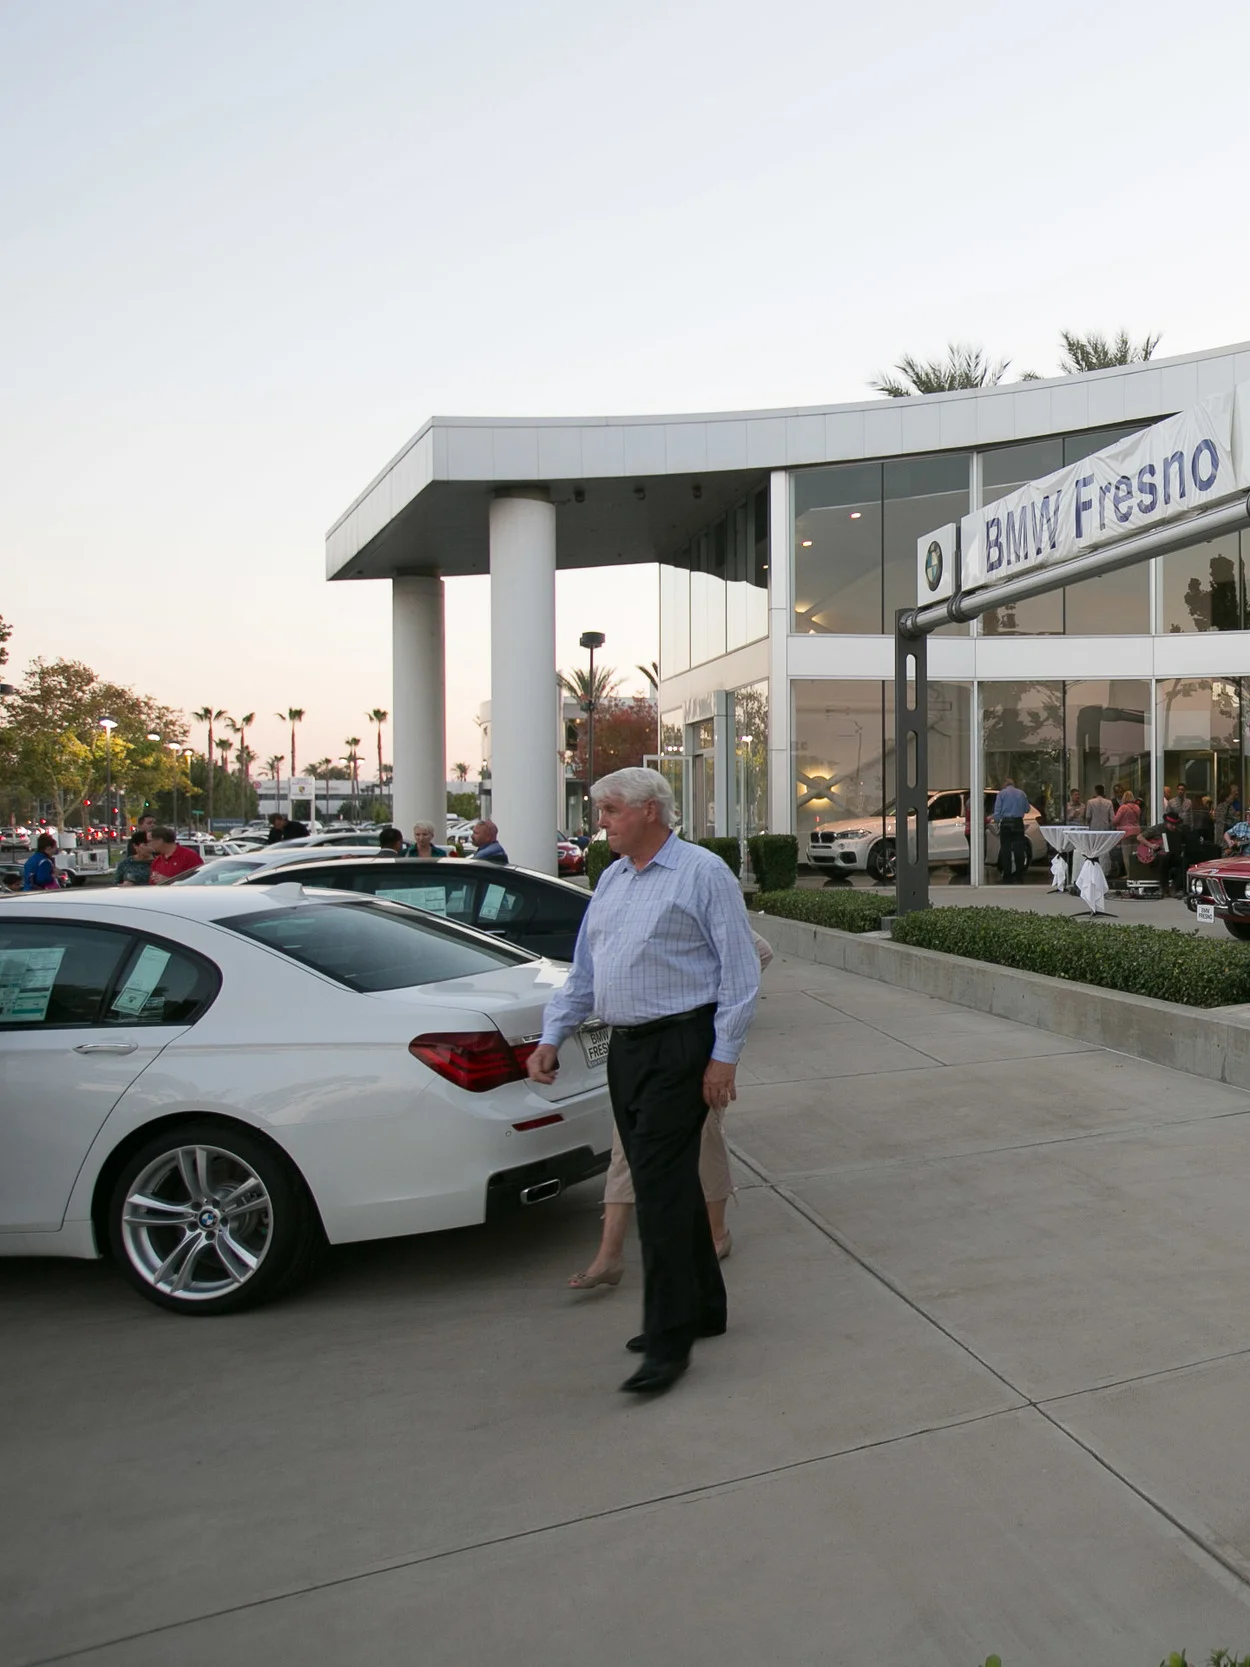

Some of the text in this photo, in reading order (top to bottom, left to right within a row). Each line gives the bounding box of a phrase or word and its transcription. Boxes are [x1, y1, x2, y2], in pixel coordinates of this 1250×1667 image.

[985, 438, 1220, 573] BMW Fresno
[590, 1029, 609, 1044] BMW
[588, 1042, 609, 1059] FRES
